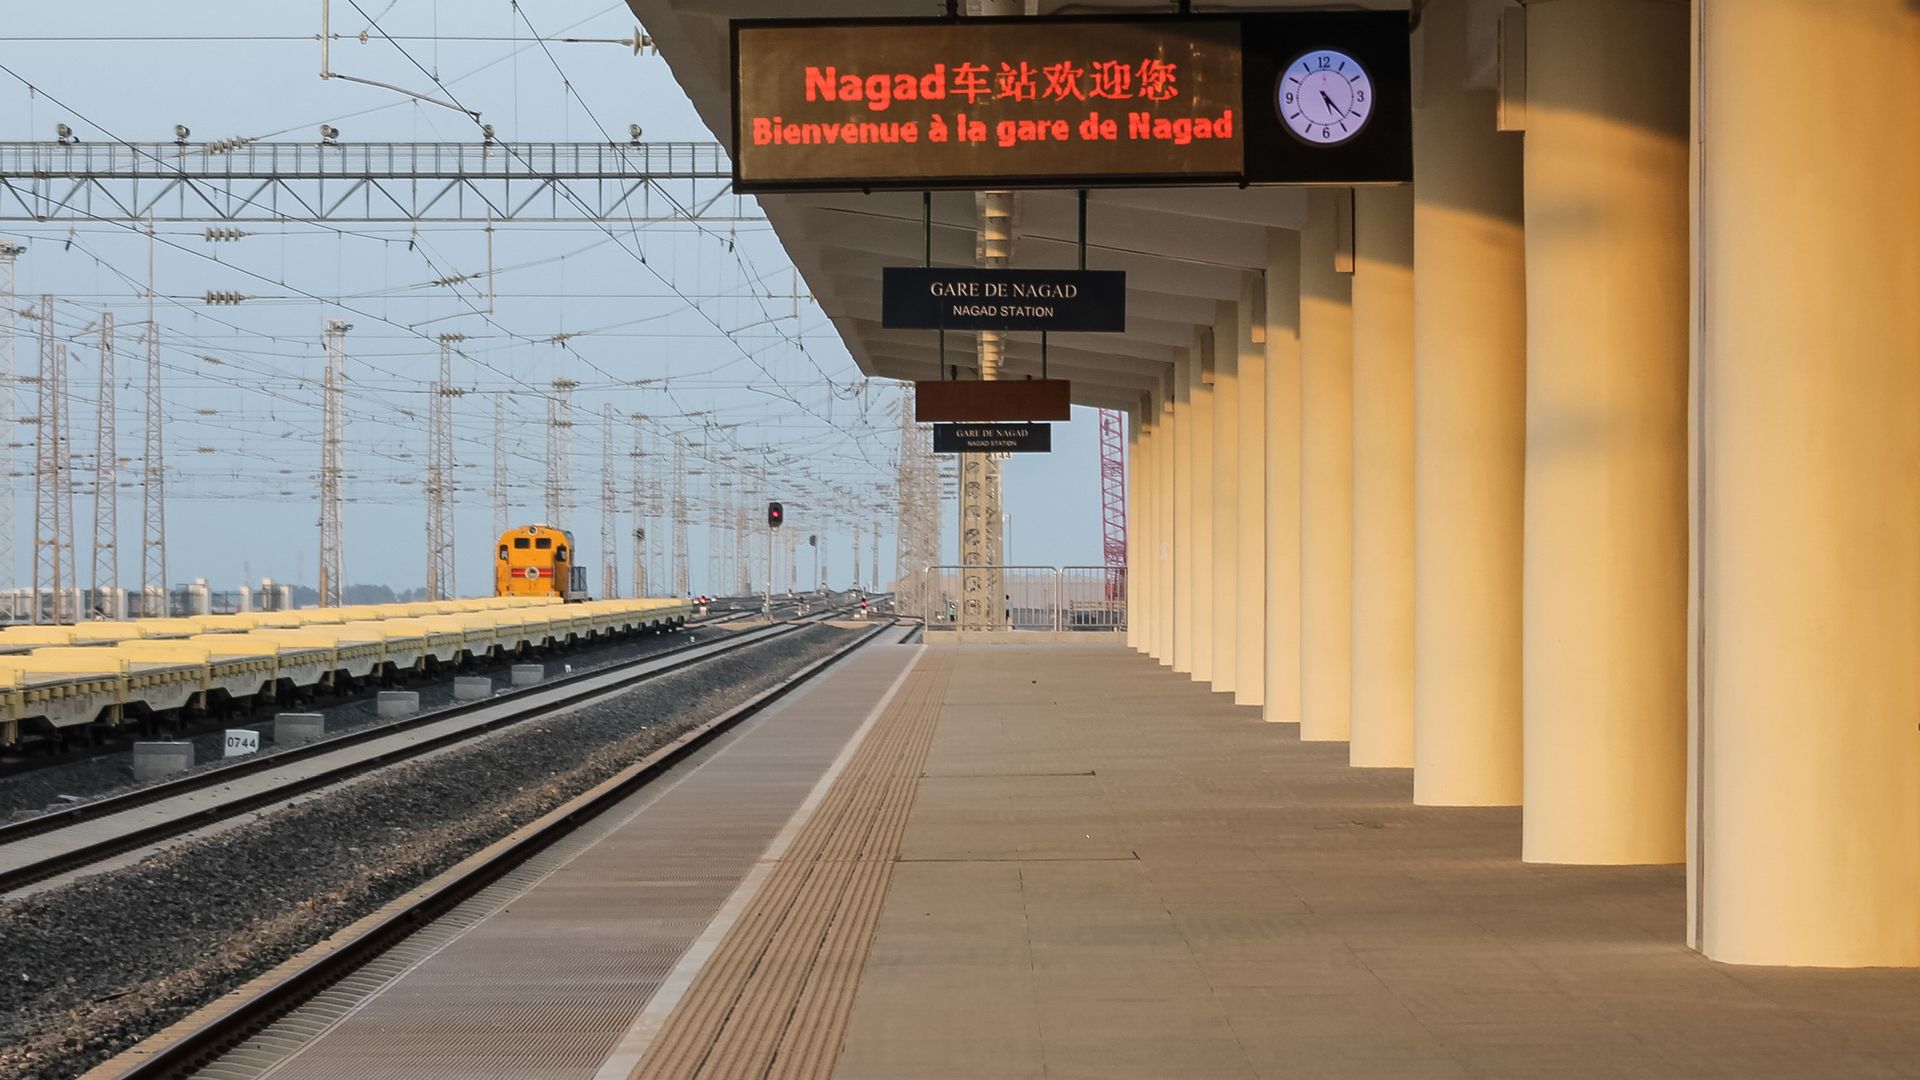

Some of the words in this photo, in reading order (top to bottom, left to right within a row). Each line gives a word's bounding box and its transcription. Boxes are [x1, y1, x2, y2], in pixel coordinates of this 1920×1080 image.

[1317, 56, 1331, 69] 12
[1285, 92, 1294, 104] 9
[1356, 90, 1365, 103] 3
[753, 116, 919, 145] Bienvenue
[928, 113, 948, 143] à
[957, 113, 987, 142] la
[996, 119, 1070, 147] gare
[1079, 111, 1118, 140] de
[1128, 110, 1233, 145] Nagad
[1322, 126, 1331, 139] 6
[930, 281, 980, 297] GARE
[984, 282, 1009, 298] DE
[1012, 283, 1078, 299] NAGAD
[952, 305, 998, 317] NAGAD
[1000, 306, 1054, 318] STATION
[956, 429, 979, 438] GARE
[996, 429, 1029, 437] NAGAD
[227, 736, 256, 748] 0744
